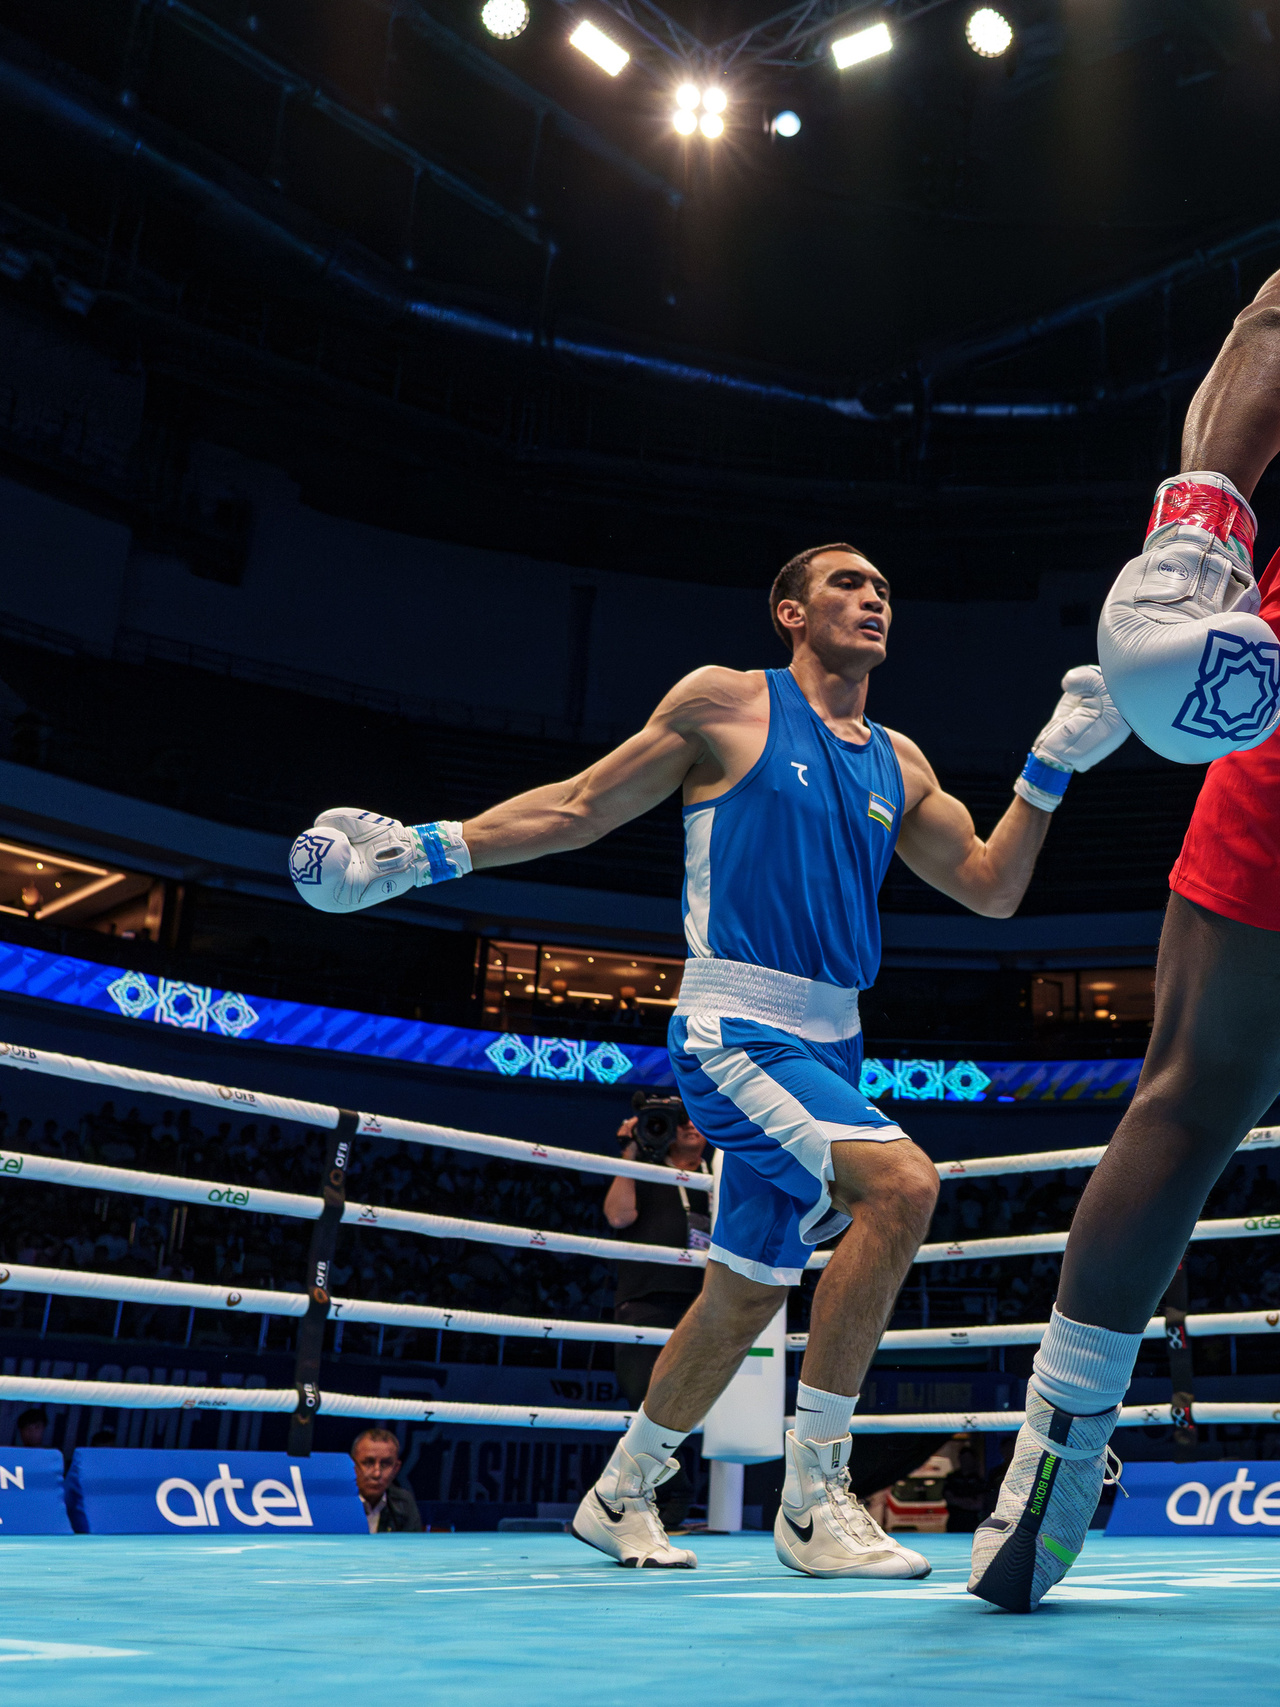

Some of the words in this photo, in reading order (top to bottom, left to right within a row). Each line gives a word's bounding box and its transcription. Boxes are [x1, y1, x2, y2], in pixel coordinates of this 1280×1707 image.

[207, 1187, 250, 1206] artel
[156, 1463, 314, 1527] artel
[1030, 1480, 1049, 1516] BOXING
